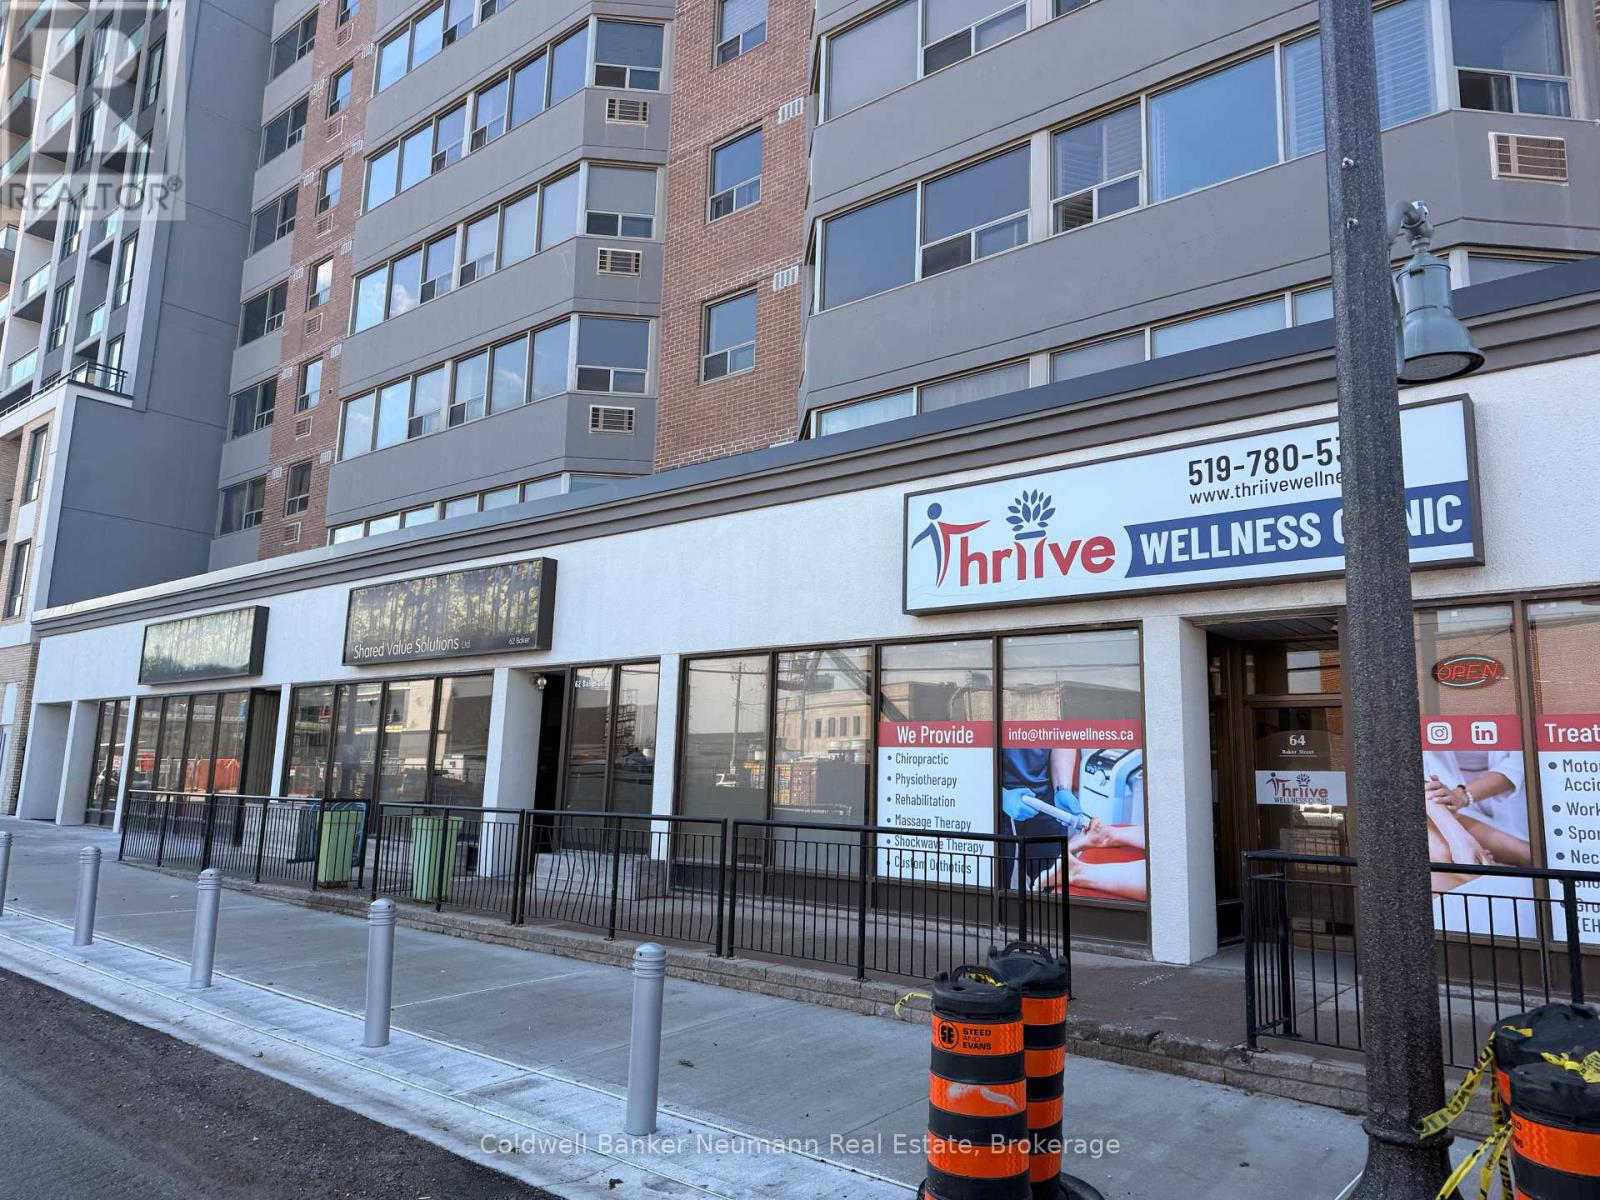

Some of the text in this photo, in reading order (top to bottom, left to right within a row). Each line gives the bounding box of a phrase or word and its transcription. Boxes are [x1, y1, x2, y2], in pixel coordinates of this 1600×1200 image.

[1140, 511, 1321, 566] WELLNESS
[353, 644, 385, 659] Shared
[387, 639, 413, 656] Value
[415, 636, 460, 654] Solutions
[1438, 663, 1498, 681] OPEN
[896, 725, 974, 744] We Provide
[1008, 727, 1134, 742] info@thriivewellness.ca
[1289, 734, 1306, 746] 64
[1544, 723, 1600, 743] Treat
[895, 752, 949, 767] Chiropractic
[1562, 758, 1600, 773] Moto
[895, 773, 958, 789] Physiotherapy
[895, 794, 956, 808] Rehabilitation
[895, 814, 972, 832] Massage Therapy
[894, 835, 985, 855] Shockwave Therapy
[963, 1028, 992, 1036] STEED
[963, 1042, 992, 1050] EVANS
